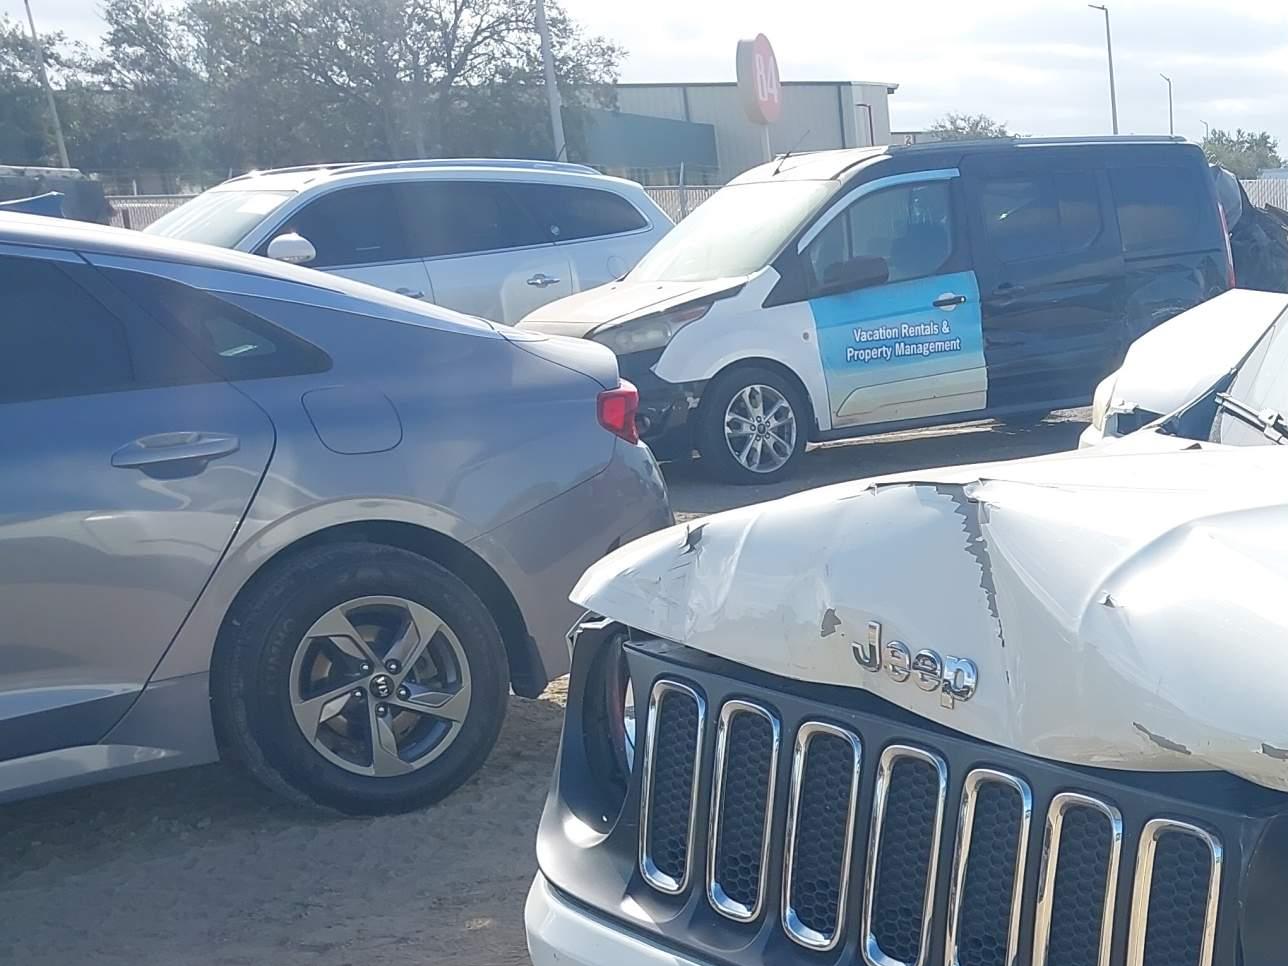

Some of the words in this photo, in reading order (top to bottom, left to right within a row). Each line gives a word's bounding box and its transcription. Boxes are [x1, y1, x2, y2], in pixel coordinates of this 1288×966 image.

[853, 326, 899, 342] Vacation
[901, 320, 939, 339] Rentals
[941, 320, 950, 334] &
[846, 345, 893, 363] Property
[895, 337, 961, 357] Management
[851, 620, 979, 710] Jeep
[377, 676, 389, 697] KIA
